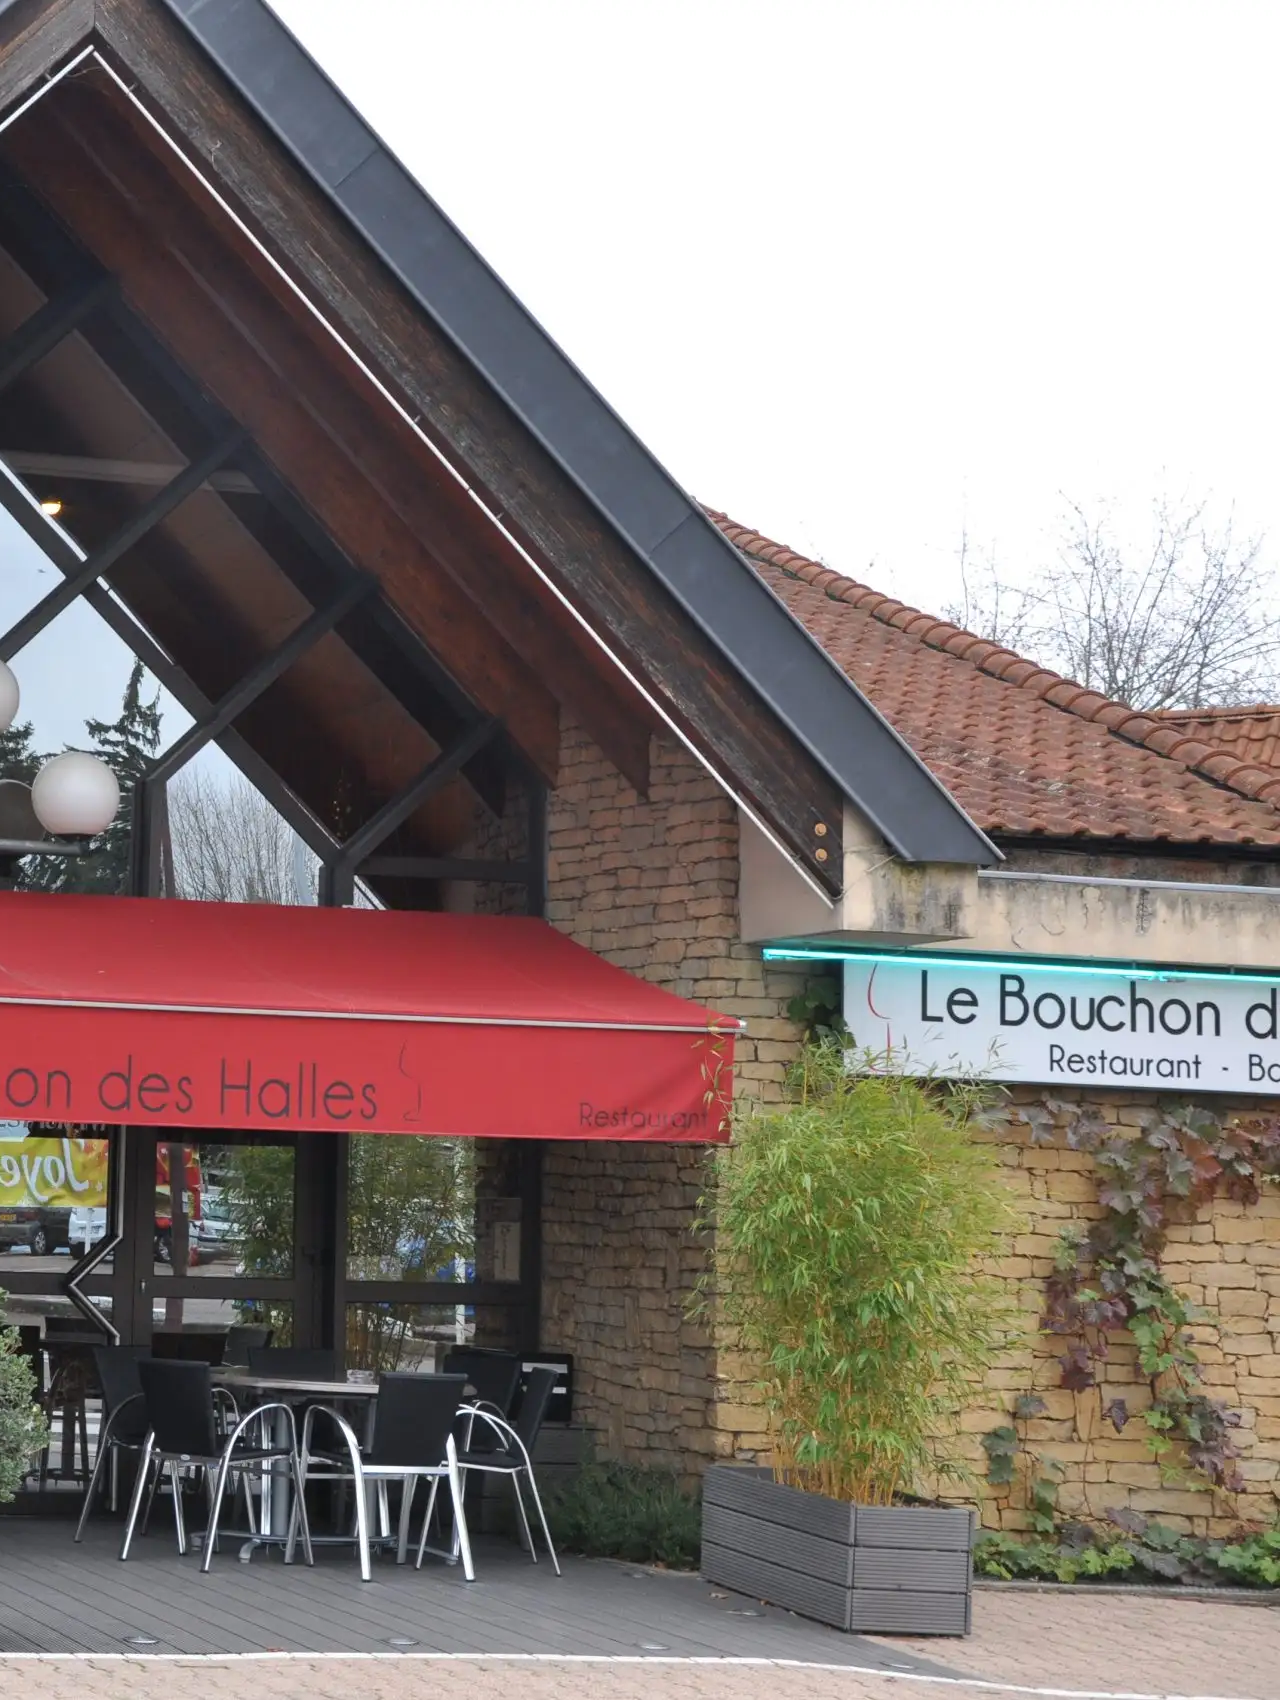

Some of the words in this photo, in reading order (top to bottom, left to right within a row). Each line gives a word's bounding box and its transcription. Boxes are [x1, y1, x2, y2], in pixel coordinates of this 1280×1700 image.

[920, 969, 980, 1026] Le
[999, 973, 1223, 1037] Bouchon
[97, 1053, 195, 1114] des
[219, 1057, 380, 1122] Halles
[1049, 1044, 1203, 1080] Restaurant
[578, 1101, 709, 1130] Restaurant
